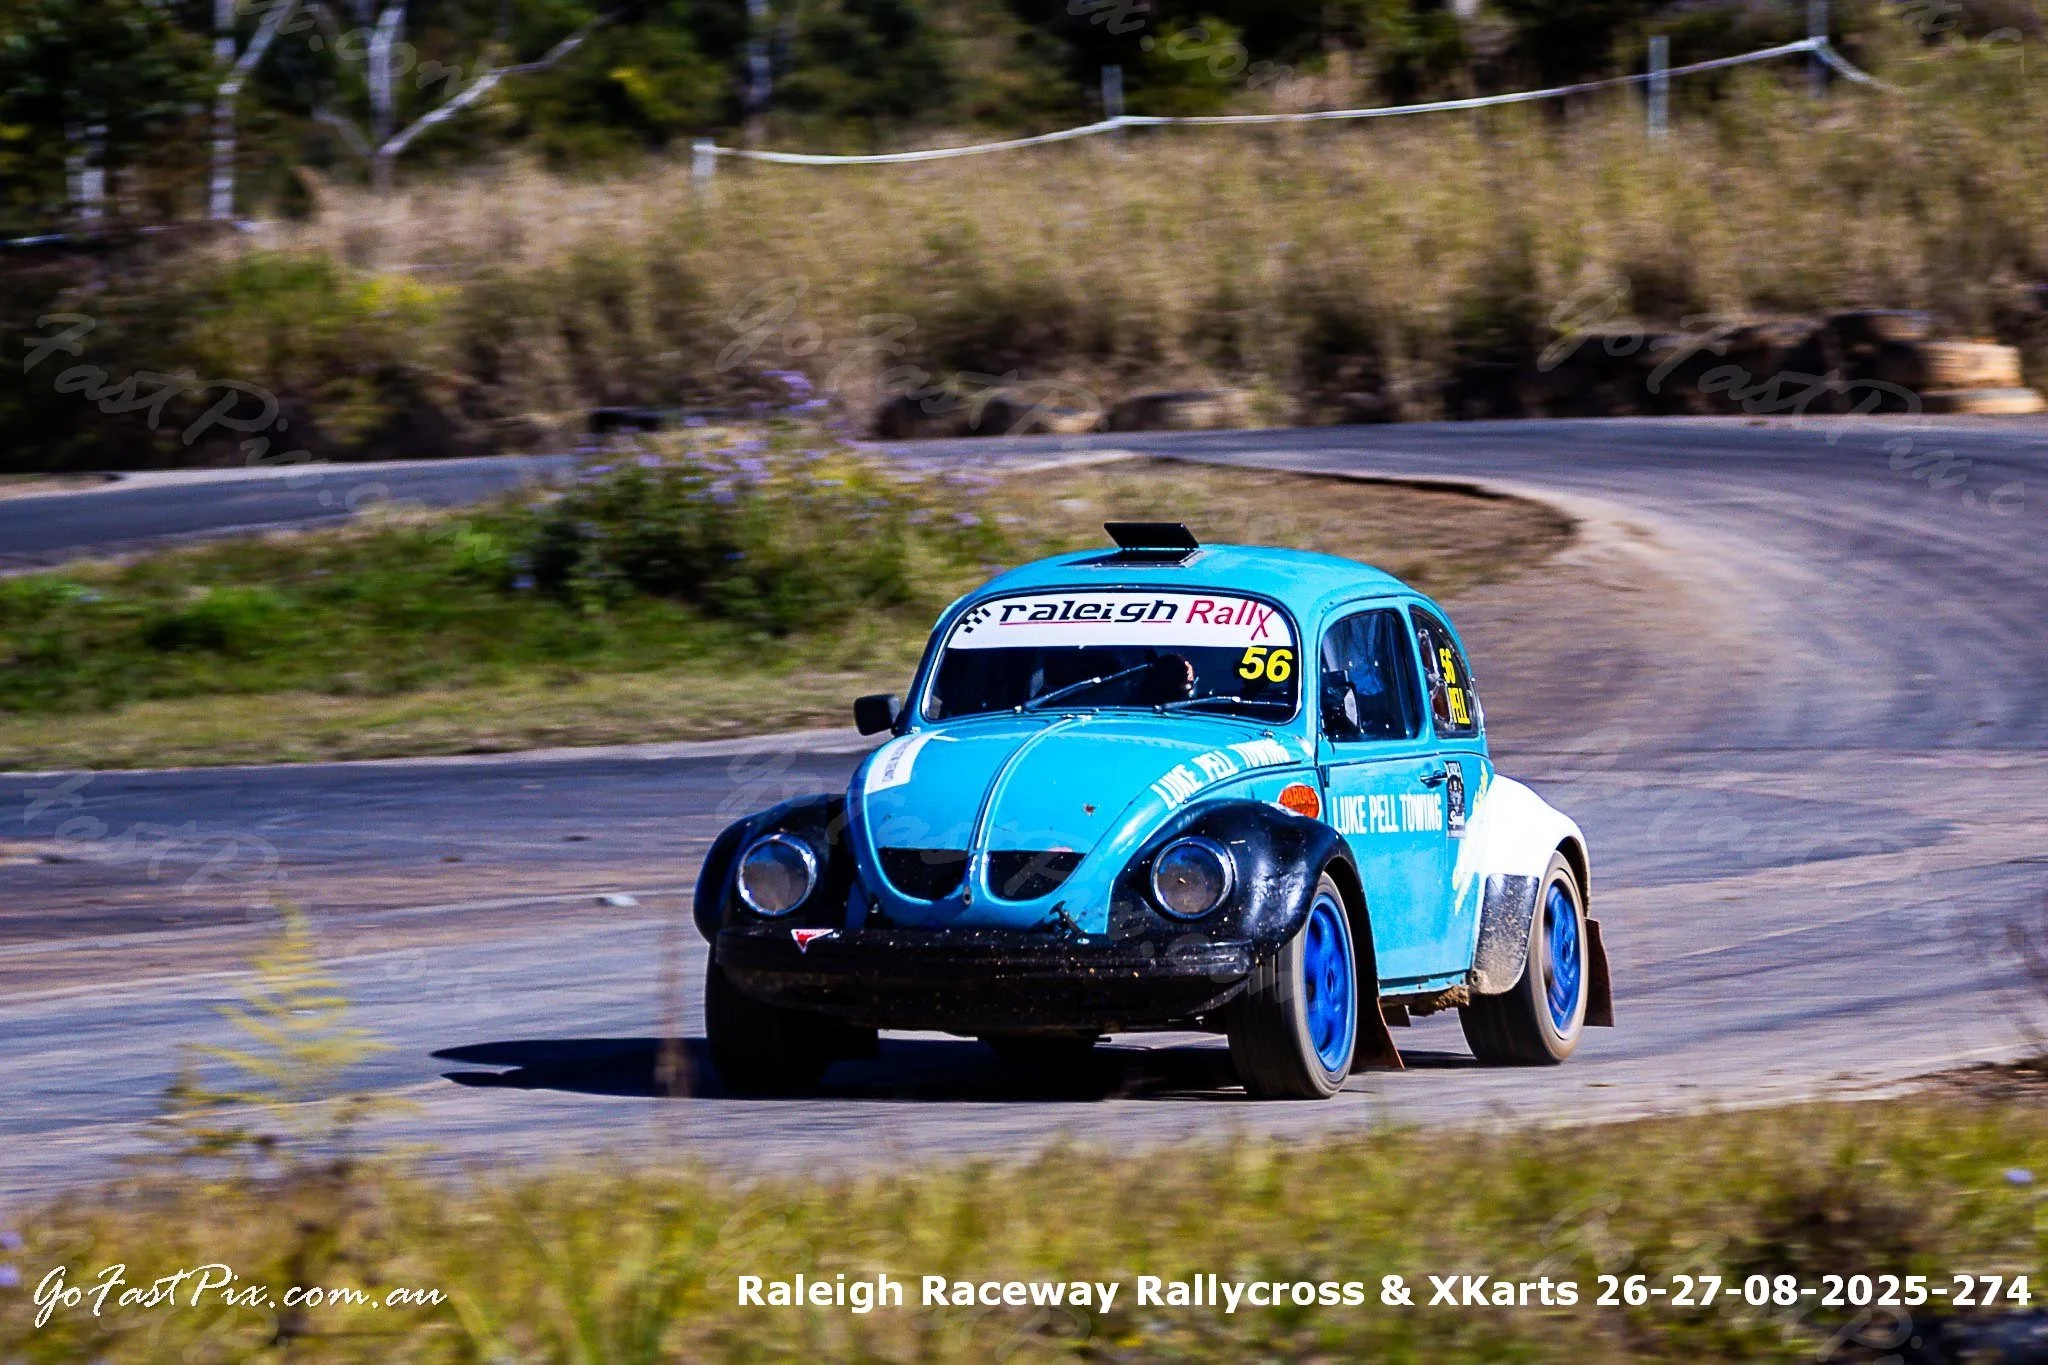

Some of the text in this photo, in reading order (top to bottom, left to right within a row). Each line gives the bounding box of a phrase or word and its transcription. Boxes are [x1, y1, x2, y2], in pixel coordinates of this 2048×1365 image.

[999, 600, 1179, 624] raleigh
[1238, 646, 1293, 683] 56
[1439, 648, 1456, 684] 56
[1150, 763, 1204, 811] LUKE
[1191, 750, 1240, 784] PELL
[1332, 795, 1368, 835] LUKE
[1368, 794, 1399, 834] PELL
[1399, 793, 1443, 833] TOWING
